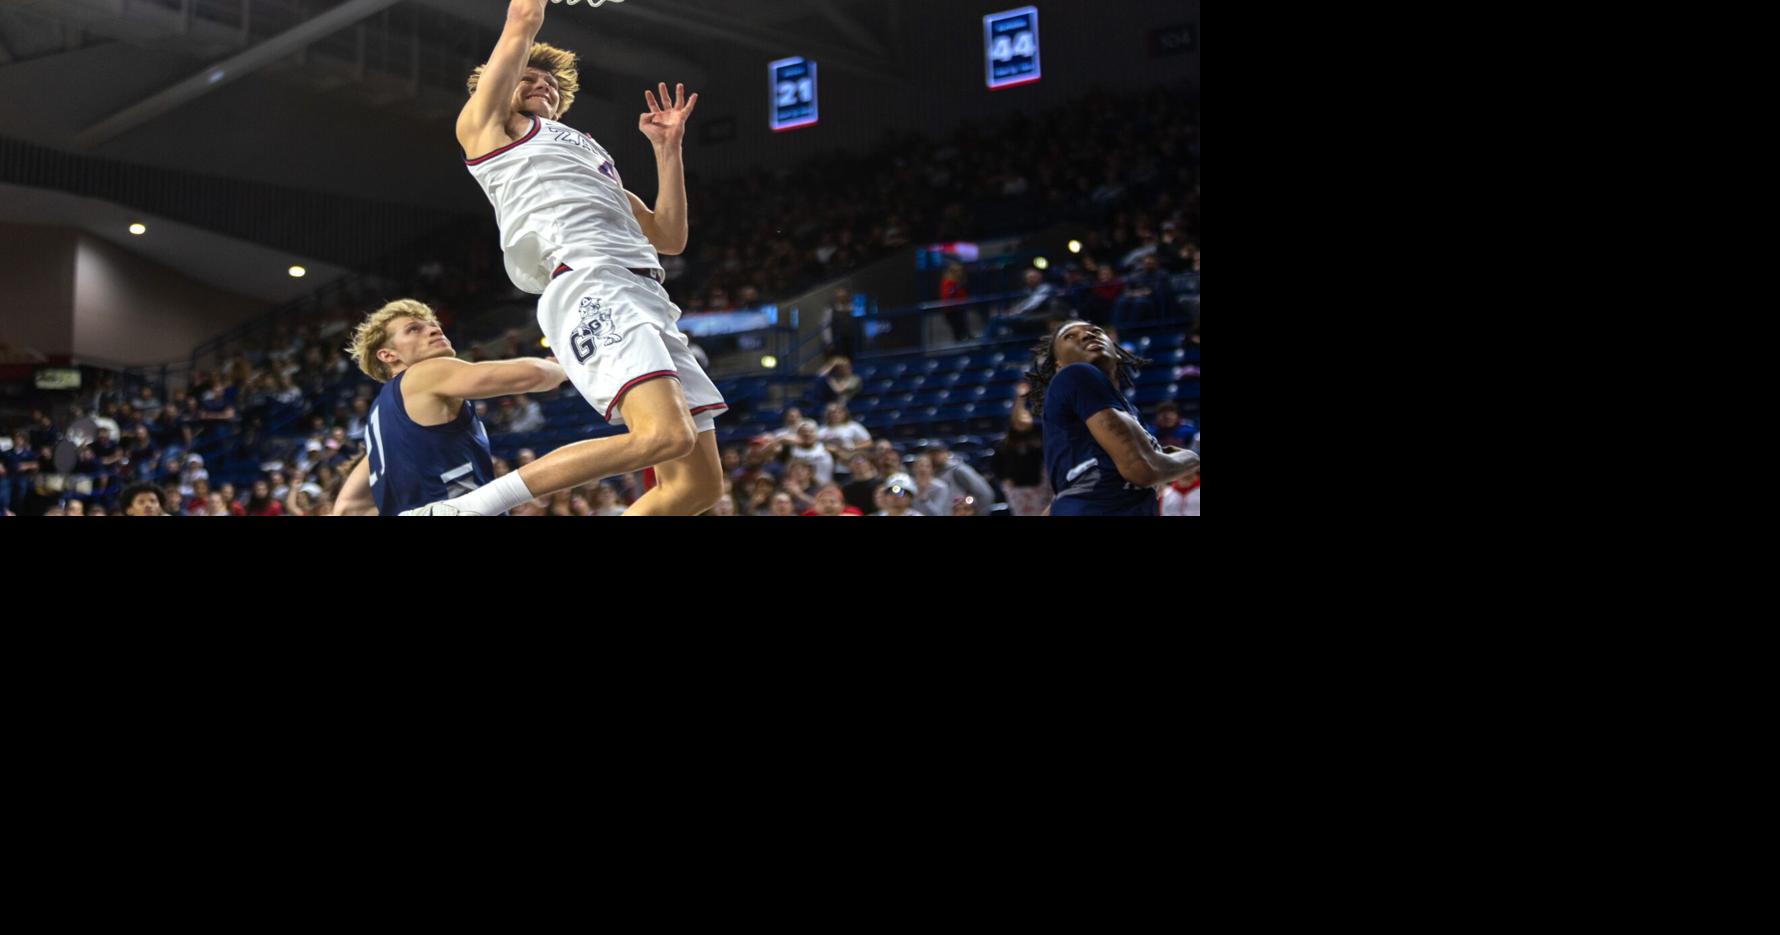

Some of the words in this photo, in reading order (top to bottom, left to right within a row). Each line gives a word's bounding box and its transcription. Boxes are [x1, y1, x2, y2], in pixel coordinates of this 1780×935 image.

[992, 31, 1036, 62] 44
[778, 78, 813, 107] 21
[570, 329, 598, 365] G
